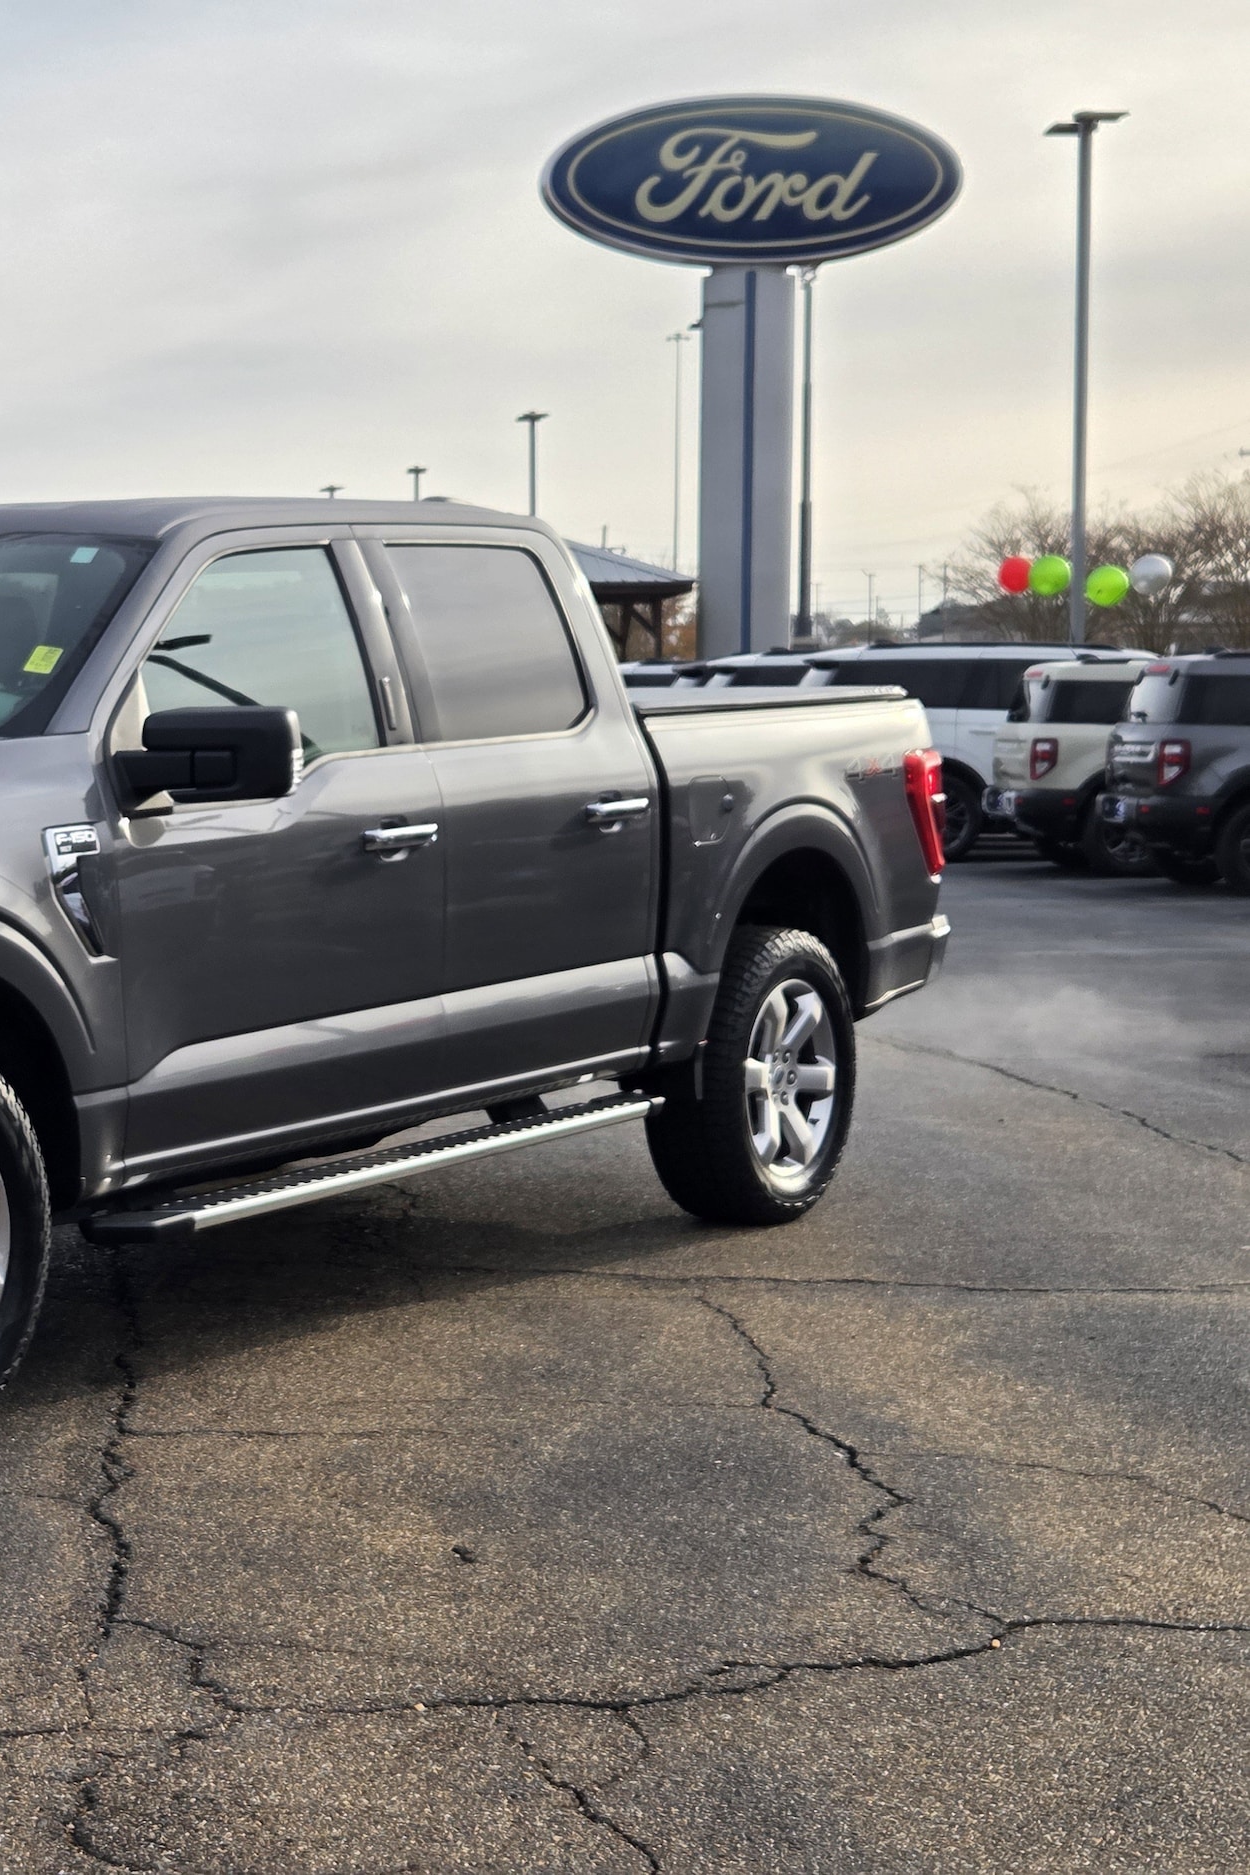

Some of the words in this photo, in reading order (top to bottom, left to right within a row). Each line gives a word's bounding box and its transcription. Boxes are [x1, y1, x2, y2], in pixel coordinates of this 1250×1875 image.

[635, 127, 879, 222] Ford
[844, 754, 898, 782] 4x4
[55, 830, 97, 846] F-150
